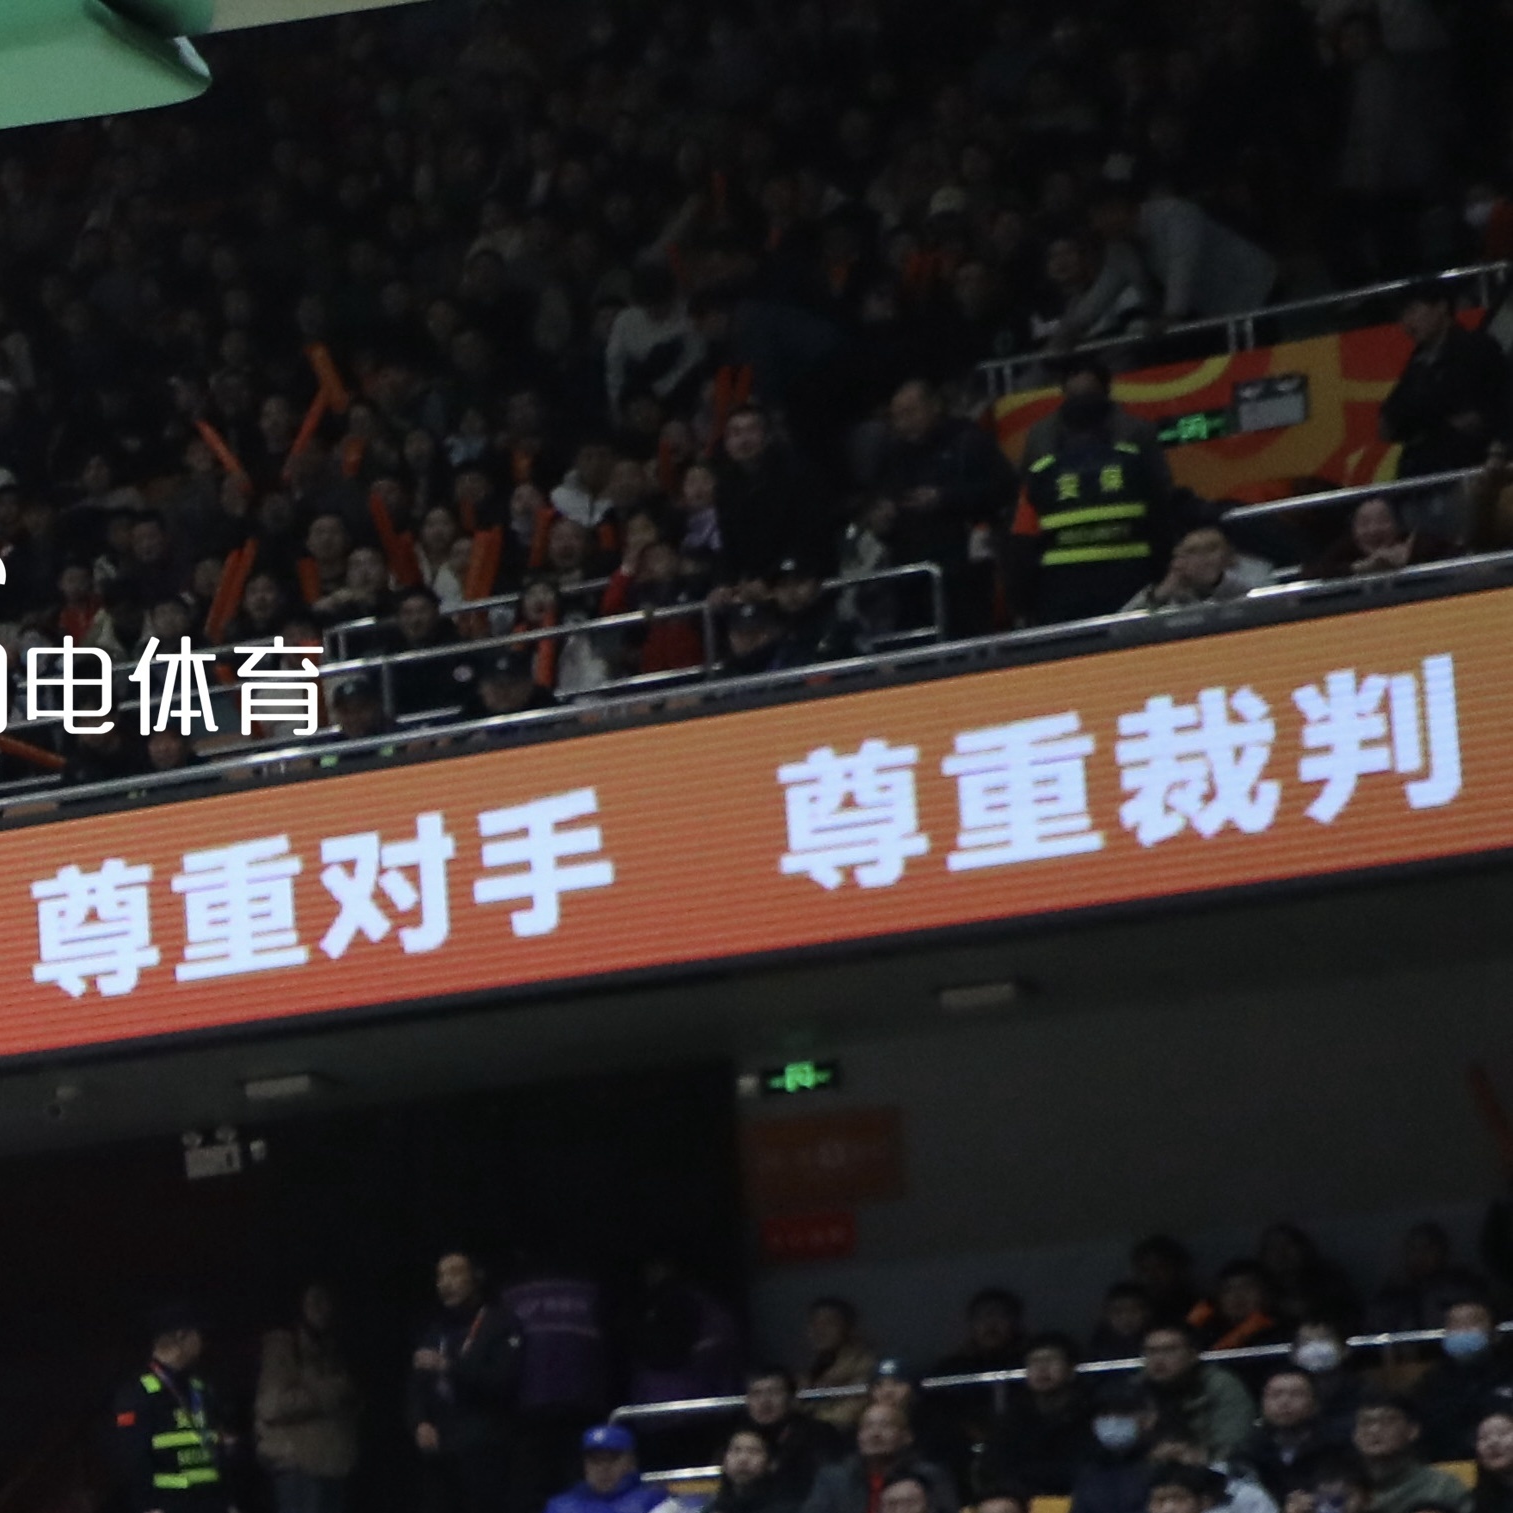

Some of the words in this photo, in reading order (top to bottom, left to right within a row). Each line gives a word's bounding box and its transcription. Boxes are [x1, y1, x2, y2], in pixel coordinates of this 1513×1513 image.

[30, 787, 616, 998] 尊重对手
[777, 653, 1463, 890] 尊重裁判
